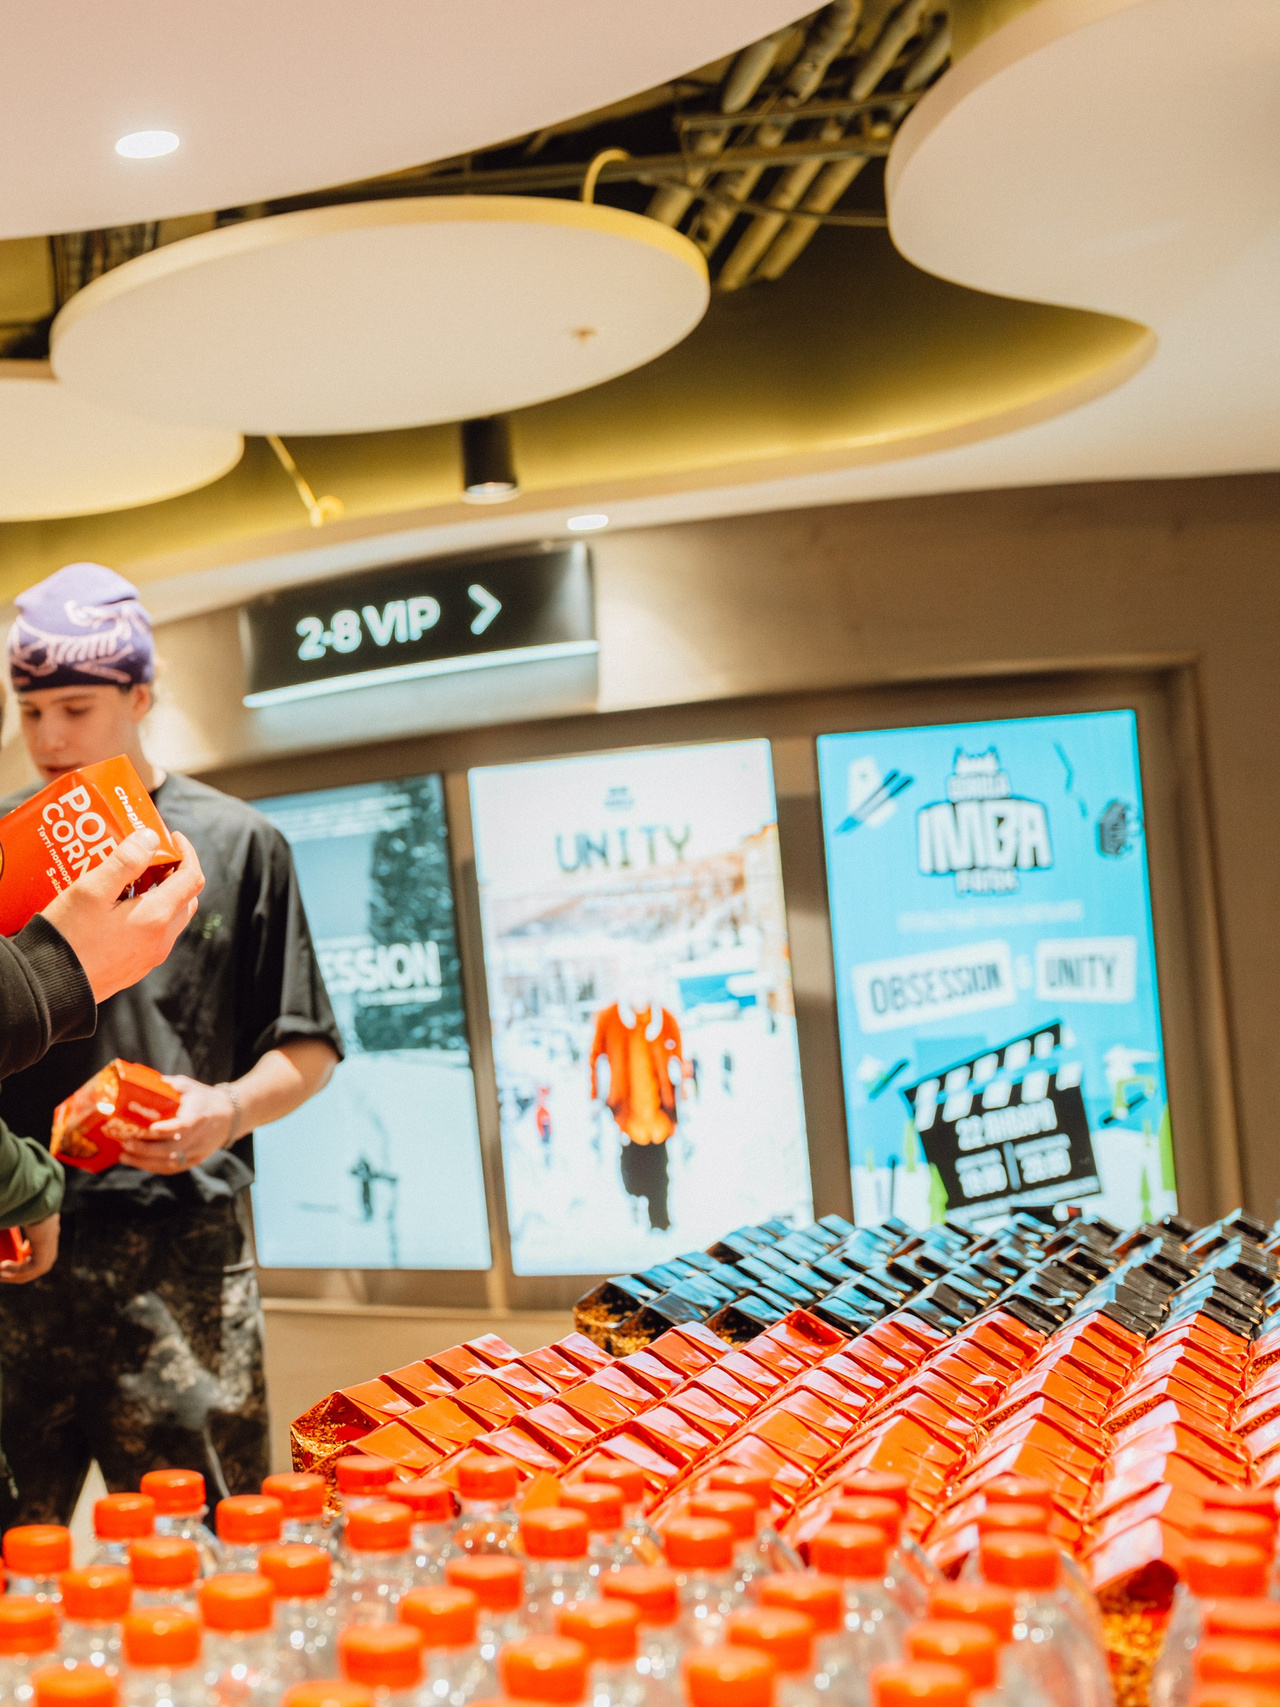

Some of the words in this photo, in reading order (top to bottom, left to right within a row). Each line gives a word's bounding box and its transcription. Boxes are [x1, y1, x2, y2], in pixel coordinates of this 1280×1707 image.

[296, 608, 362, 661] 2-8
[362, 596, 441, 647] VIP
[58, 784, 118, 862] POP
[555, 824, 692, 872] UNITY
[869, 962, 1001, 1014] OBSESSION
[1047, 956, 1117, 989] UNITY
